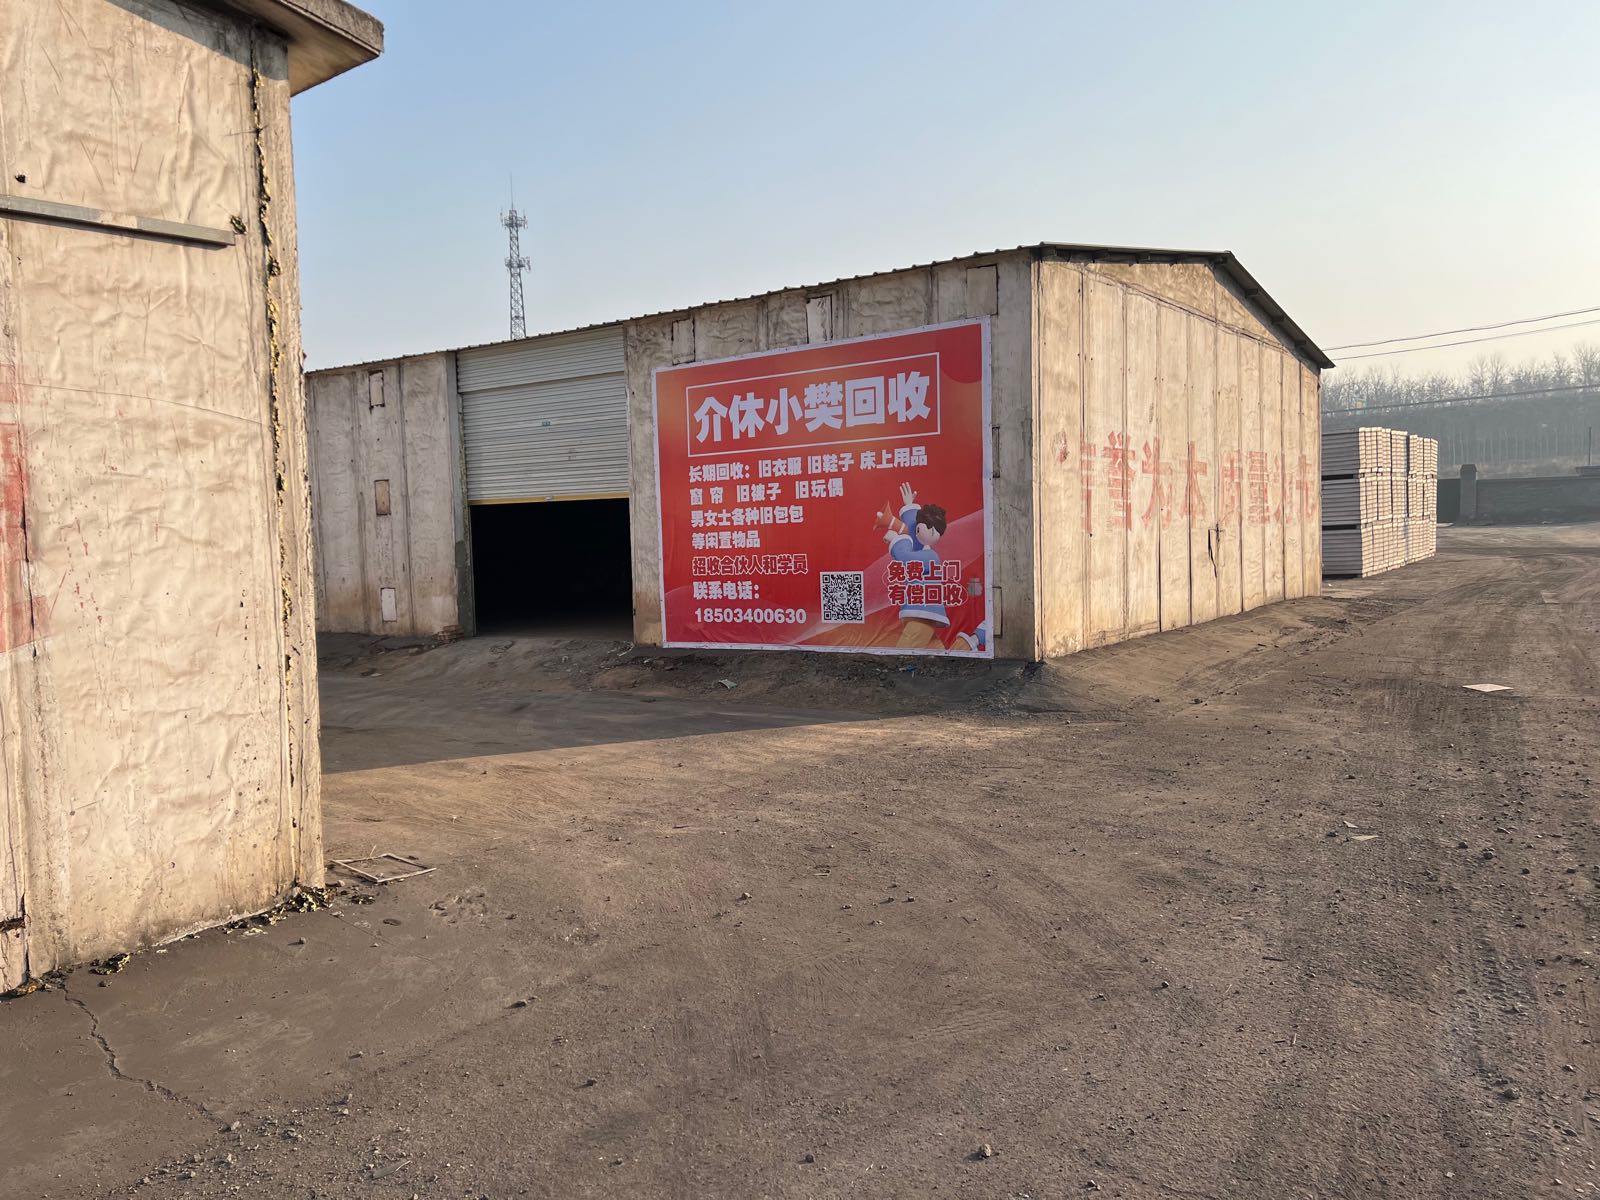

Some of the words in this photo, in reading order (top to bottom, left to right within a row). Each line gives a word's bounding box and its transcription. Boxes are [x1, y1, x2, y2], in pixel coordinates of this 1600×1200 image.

[693, 371, 931, 443] 介休小樊回收
[758, 456, 803, 479] 旧衣服
[807, 452, 855, 475] 旧鞋子
[859, 445, 928, 470] 床上用品
[736, 482, 782, 503] 旧被子
[795, 476, 844, 500] 旧玩偶
[690, 504, 804, 528] 男女士各种旧包包
[691, 530, 761, 550] 等闲置物品
[692, 553, 809, 577] 招收合伙人和学员
[887, 559, 962, 583] 免费上门
[692, 580, 760, 601] 联系电话：
[887, 583, 963, 606] 有偿回收
[694, 607, 807, 625] 18503400630
